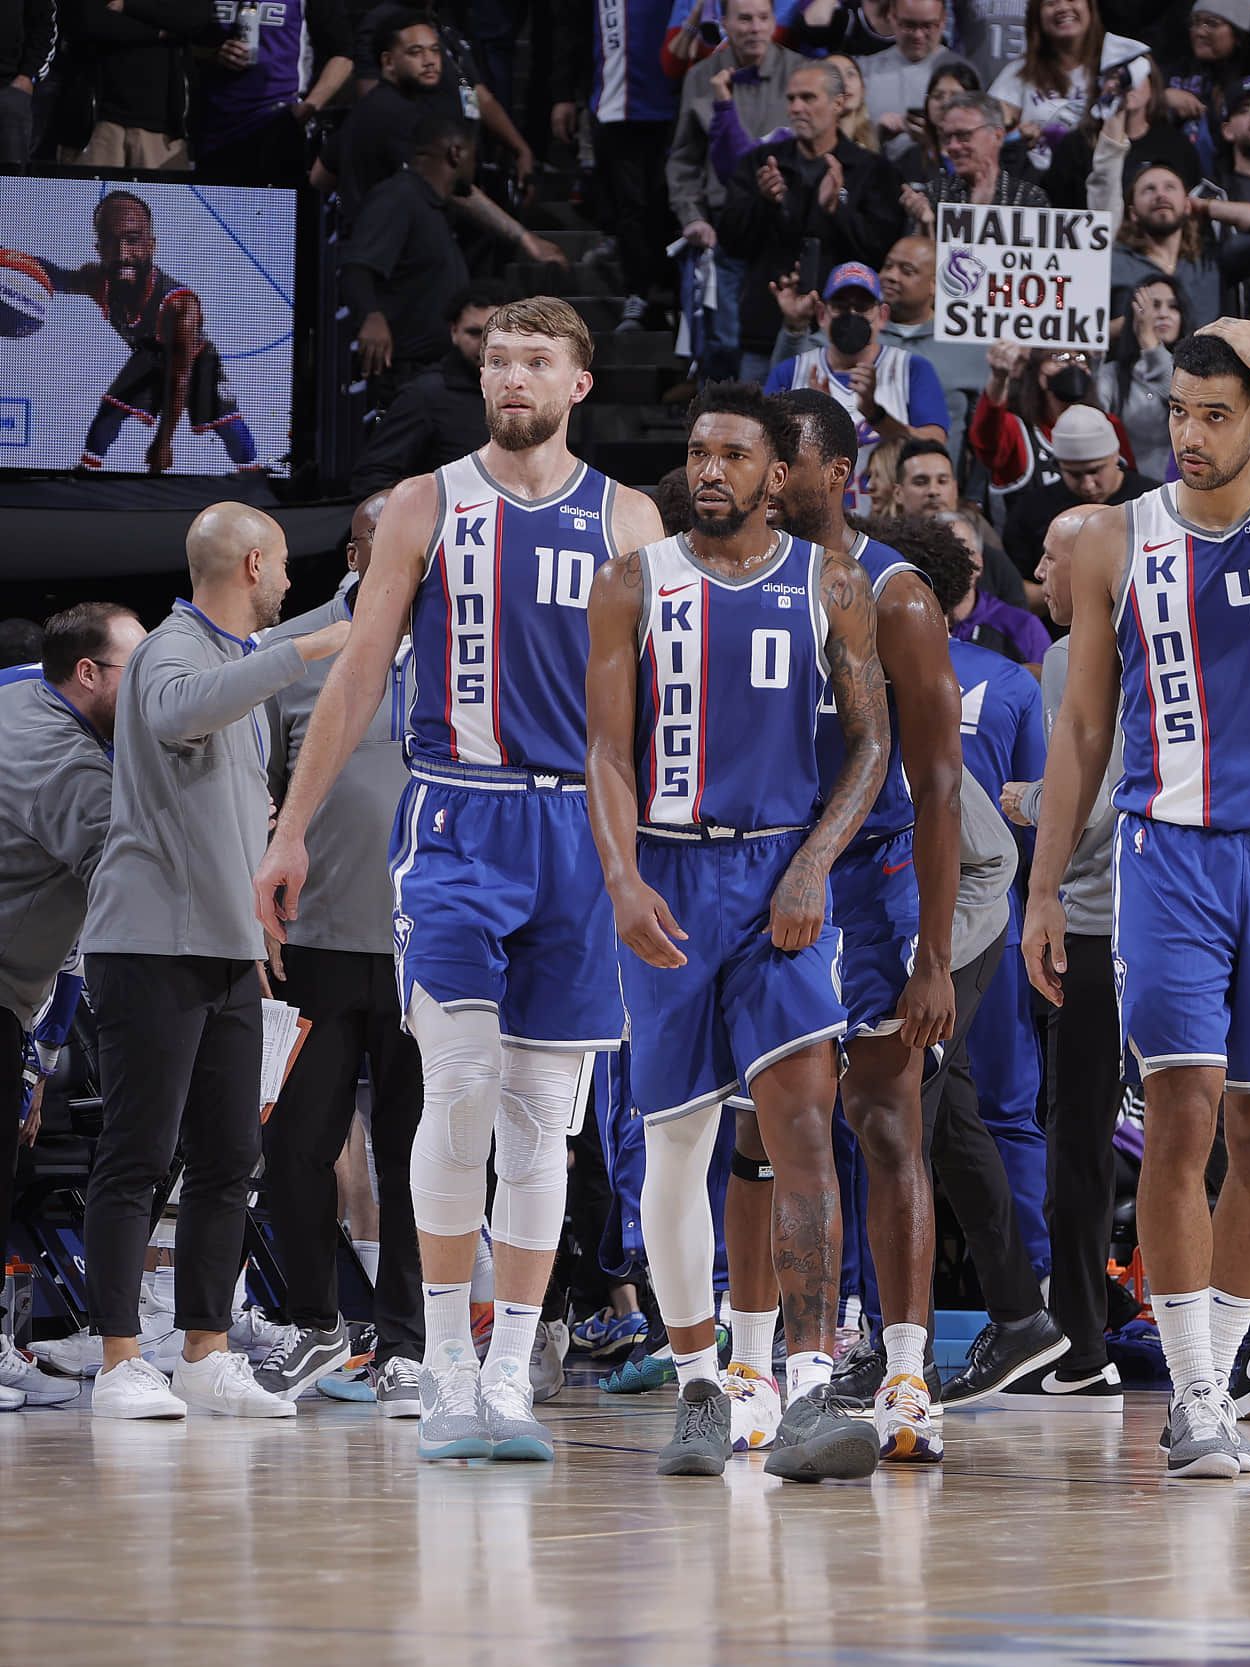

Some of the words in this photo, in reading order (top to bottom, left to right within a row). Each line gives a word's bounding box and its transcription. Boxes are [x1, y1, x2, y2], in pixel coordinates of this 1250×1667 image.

[940, 208, 1109, 251] MALIK's
[1001, 252, 1032, 271] ON
[1045, 254, 1060, 271] A
[986, 271, 1072, 310] HOT
[944, 301, 1106, 344] Streak!
[559, 504, 600, 520] dialpad
[535, 546, 595, 609] 10
[762, 582, 806, 596] dialpad
[455, 517, 488, 704] KINGS
[750, 628, 792, 689] 0
[1146, 555, 1197, 744] KINGS
[660, 600, 694, 797] KINGS
